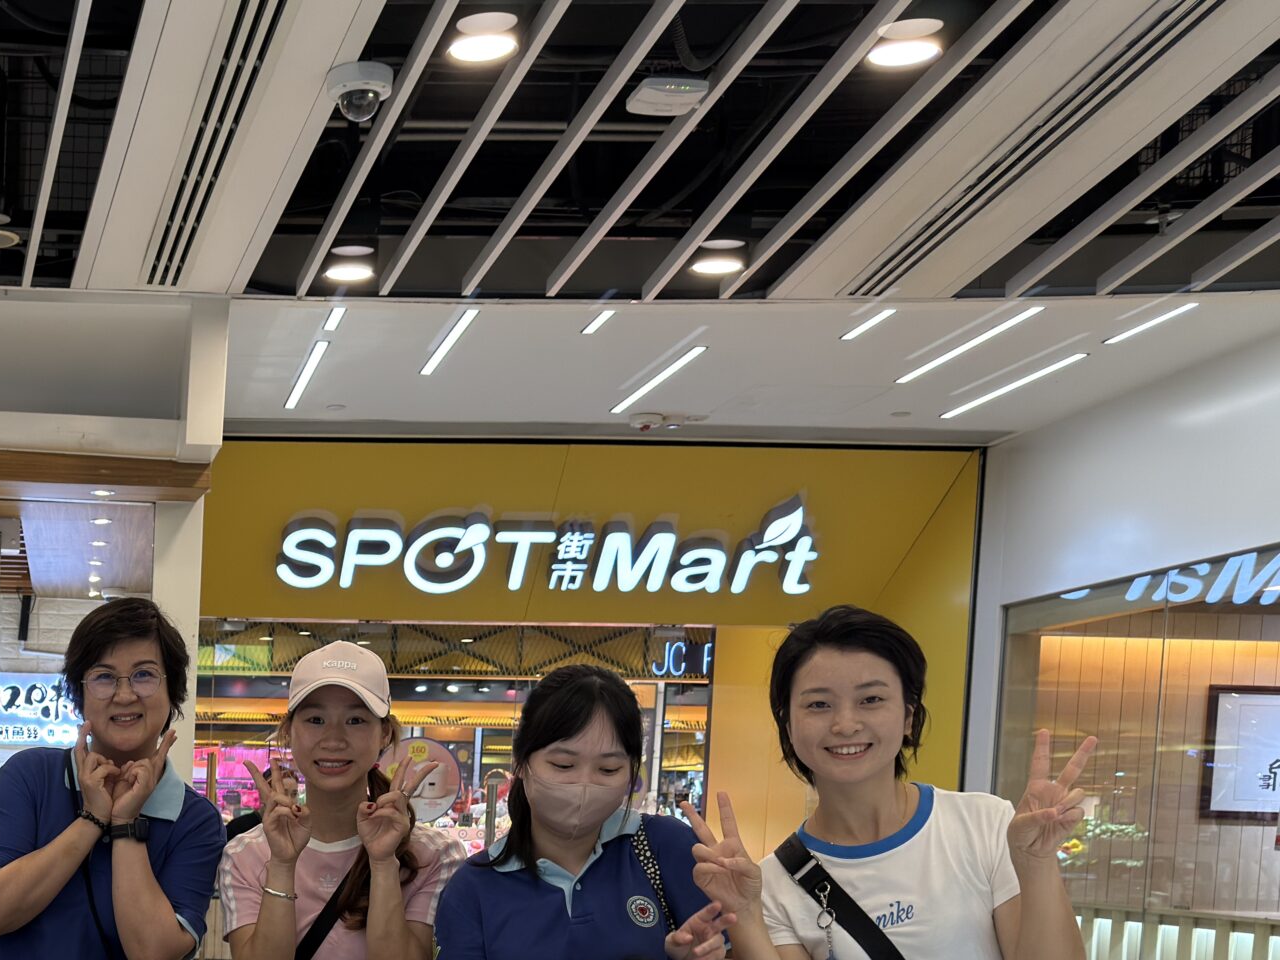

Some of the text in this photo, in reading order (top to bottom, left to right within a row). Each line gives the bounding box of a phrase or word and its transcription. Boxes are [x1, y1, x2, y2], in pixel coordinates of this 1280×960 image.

[276, 522, 818, 595] SPOT Mart
[548, 530, 595, 592] 街市
[322, 660, 357, 670] Kappa
